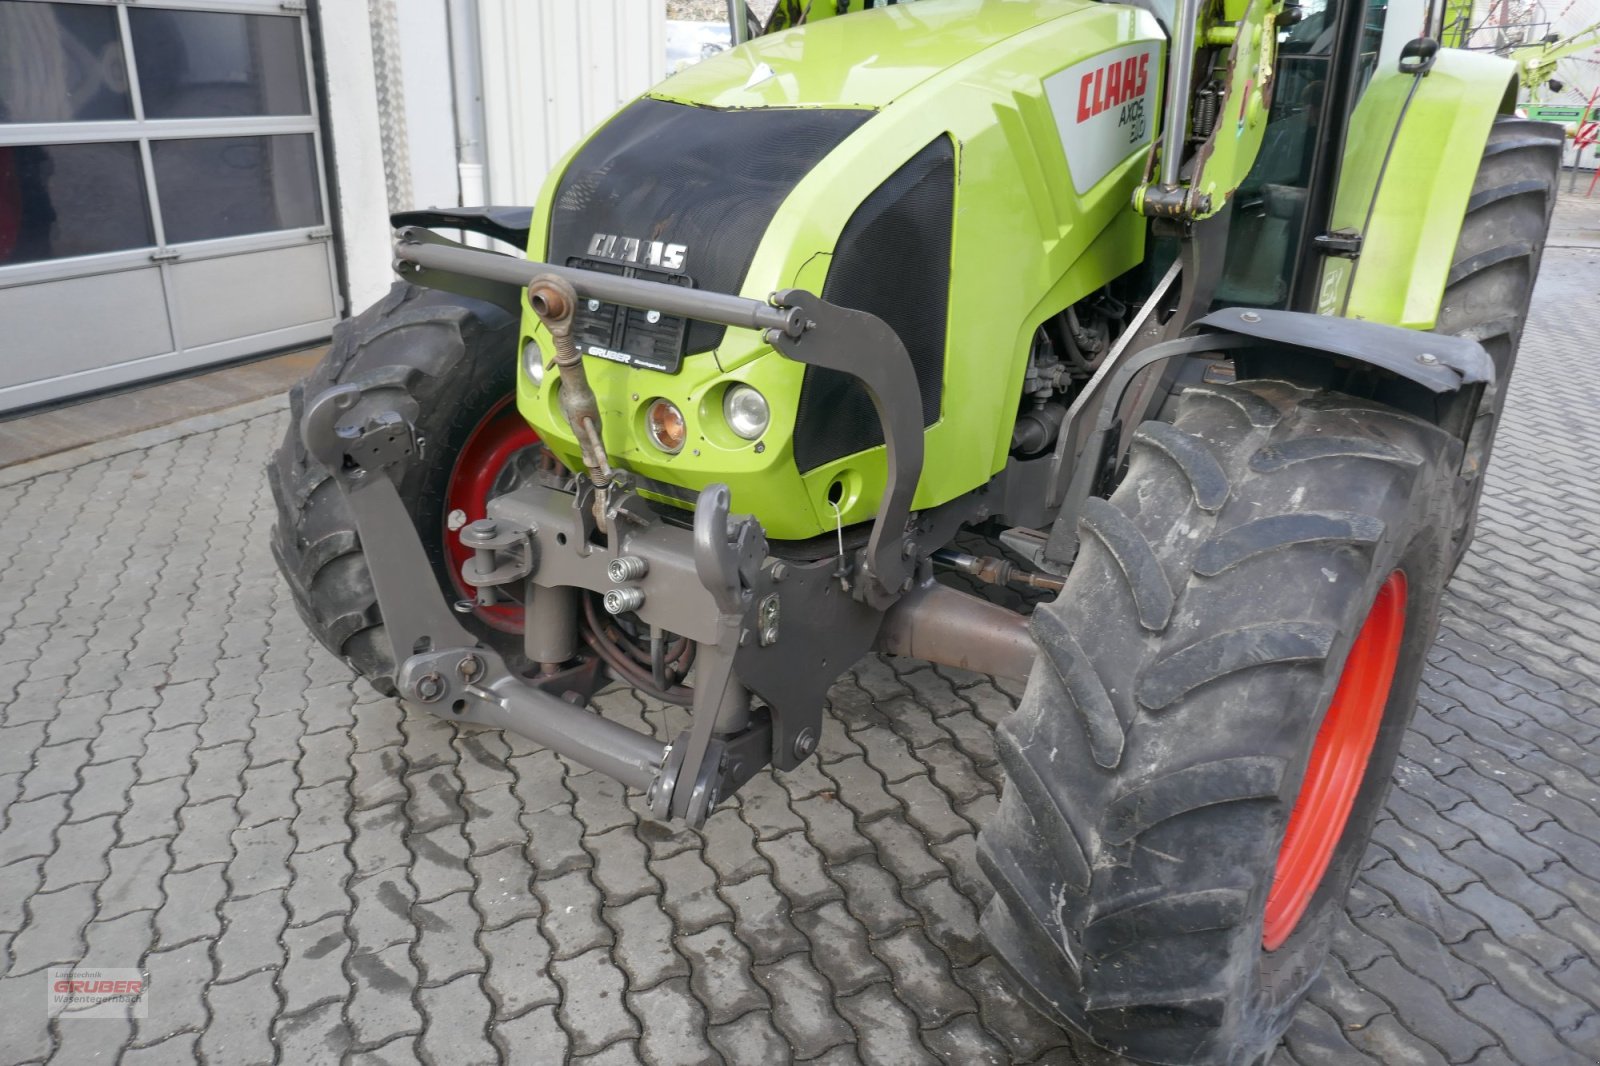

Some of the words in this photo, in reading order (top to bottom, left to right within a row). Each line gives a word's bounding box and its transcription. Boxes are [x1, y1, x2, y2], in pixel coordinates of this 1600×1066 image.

[1076, 52, 1150, 124] CLAAS
[1118, 97, 1145, 128] AXOS
[587, 233, 688, 271] CLAAS
[588, 346, 631, 364] GRUBER
